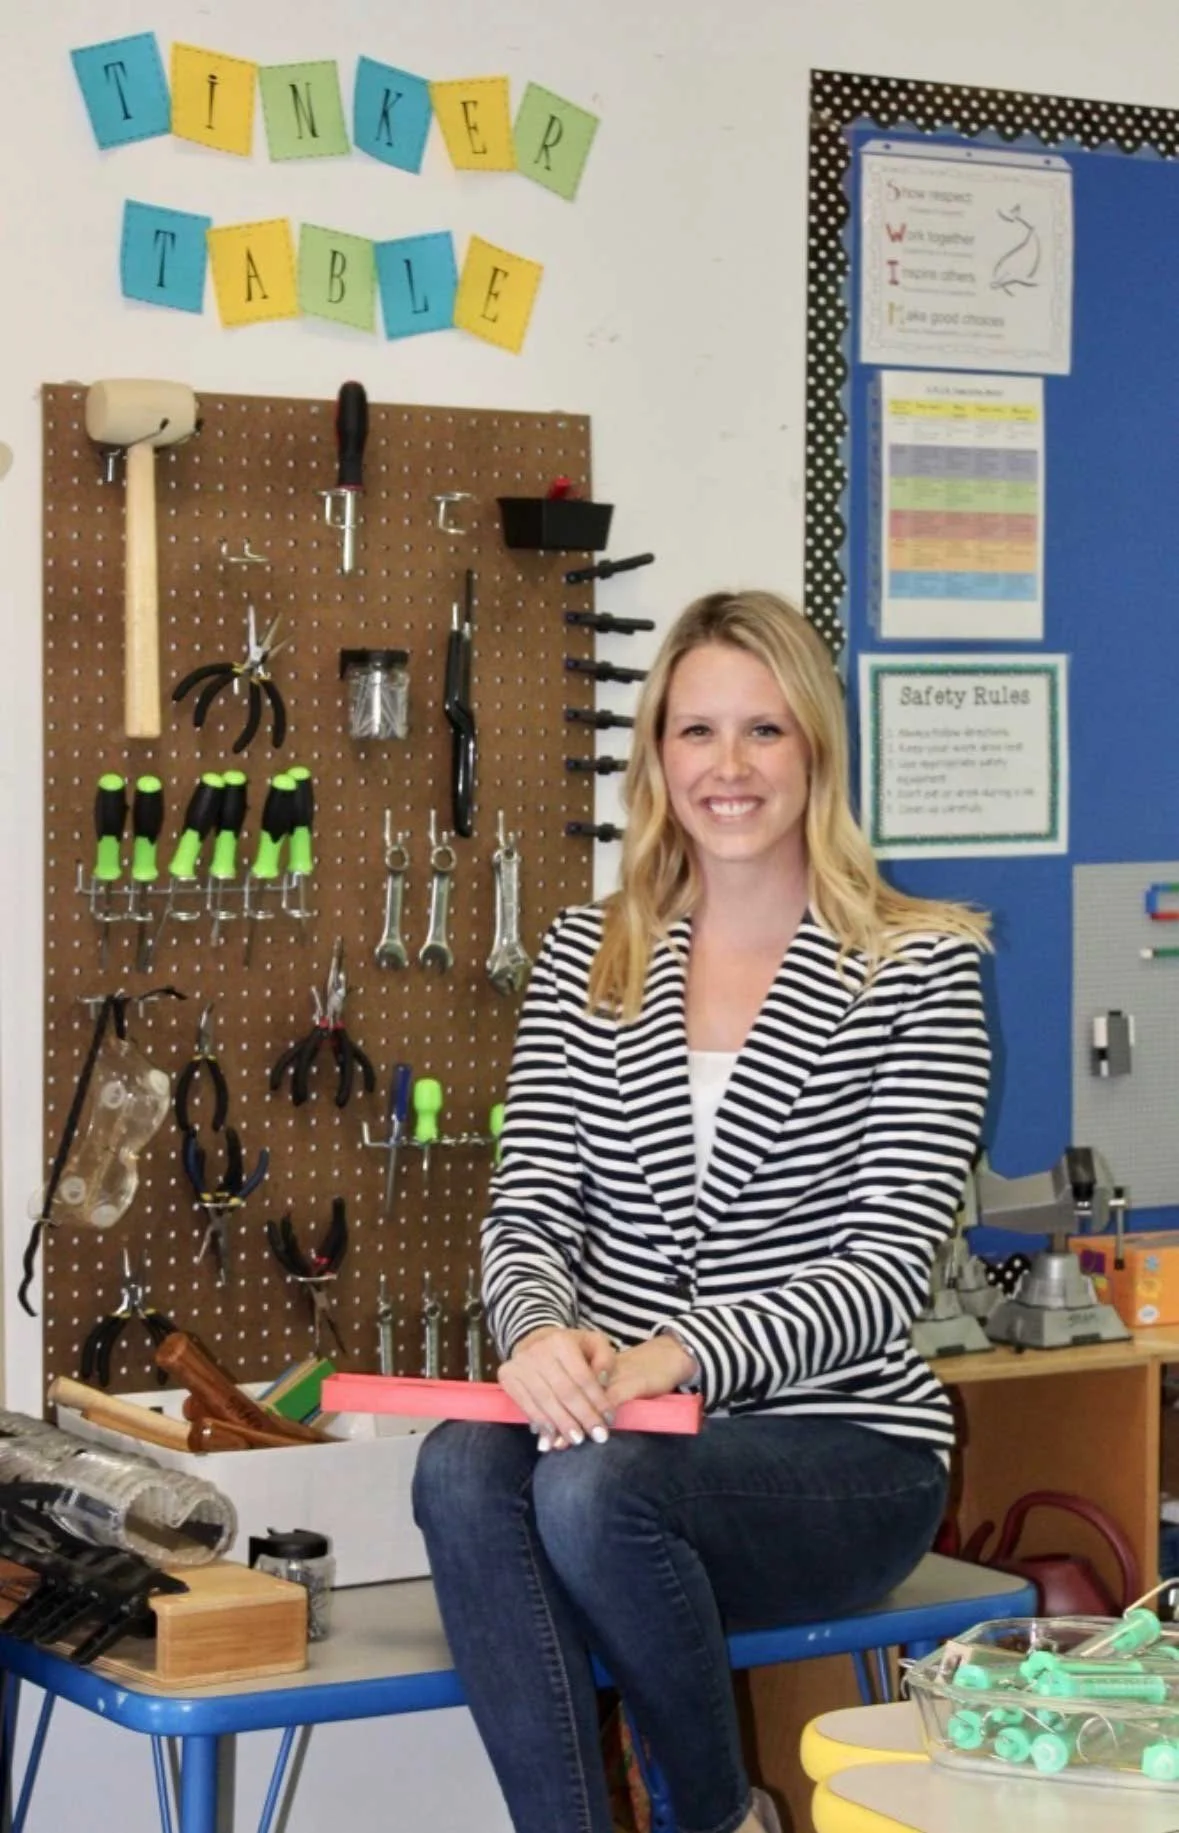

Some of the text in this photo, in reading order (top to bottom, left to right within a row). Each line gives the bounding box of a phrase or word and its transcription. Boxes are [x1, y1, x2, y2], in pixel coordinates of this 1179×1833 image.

[103, 60, 564, 171] TINKER
[154, 229, 509, 324] TABLE
[900, 685, 1032, 709] Safety Rules
